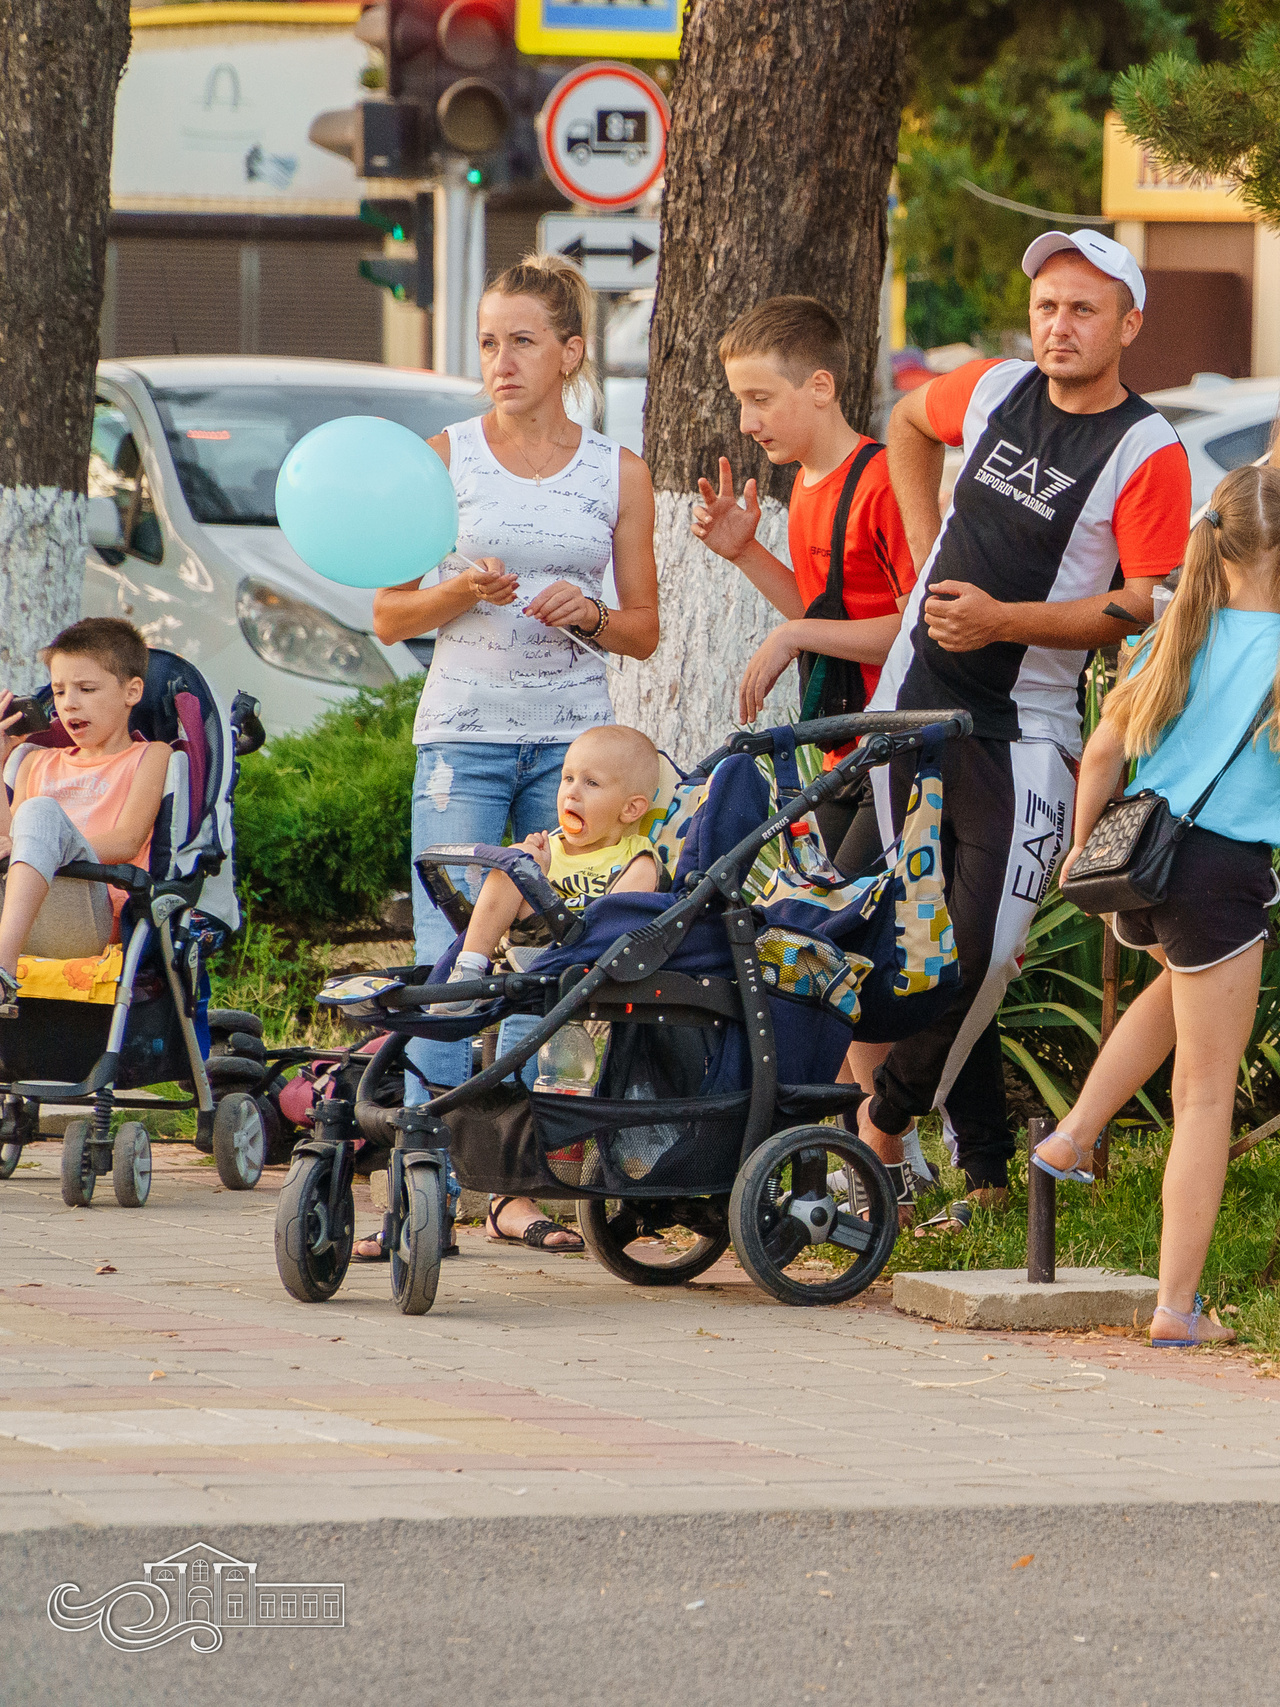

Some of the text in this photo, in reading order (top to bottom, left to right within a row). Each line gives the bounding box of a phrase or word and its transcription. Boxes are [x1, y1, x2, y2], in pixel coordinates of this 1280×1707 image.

[974, 468, 1056, 521] EMPORIO ARMANI
[982, 439, 1077, 501] EA7
[761, 815, 790, 840] RETRUS
[1011, 788, 1057, 904] EA7
[1055, 800, 1065, 842] ARMANI
